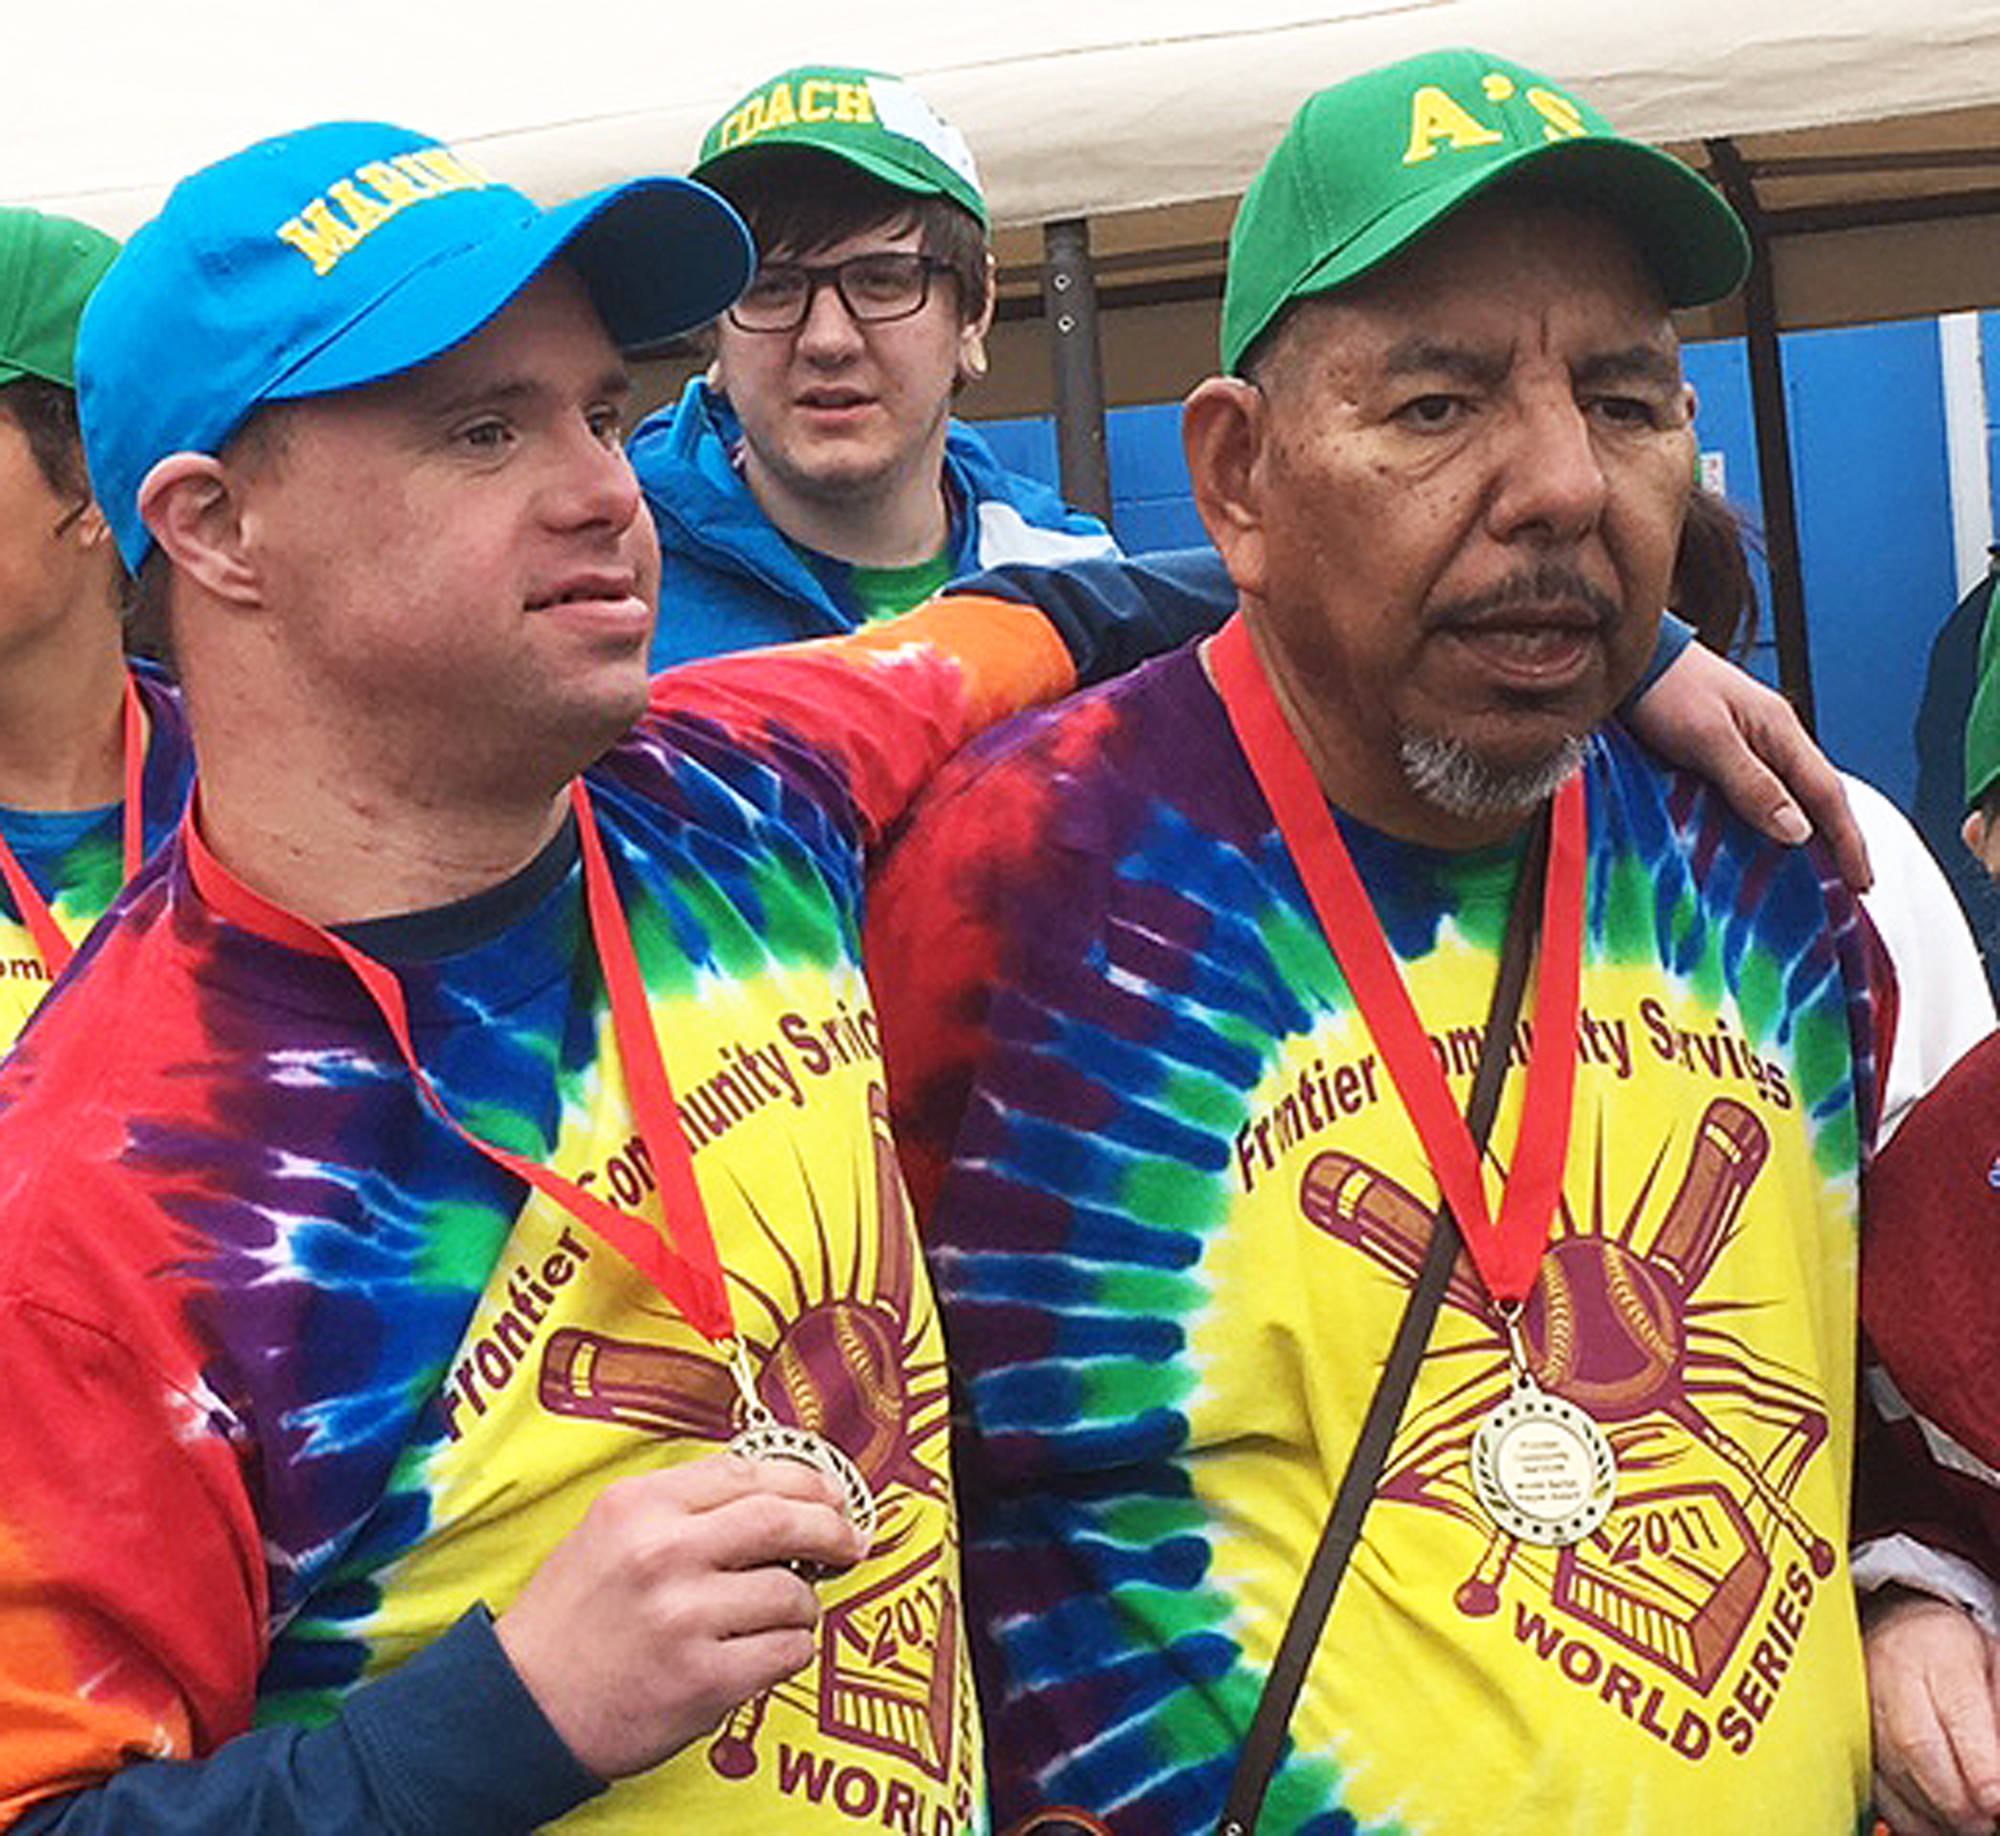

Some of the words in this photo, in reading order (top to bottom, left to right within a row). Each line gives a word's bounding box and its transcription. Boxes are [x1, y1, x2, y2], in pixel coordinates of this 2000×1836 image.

[720, 82, 876, 147] COACH
[1235, 1053, 1378, 1192] Frntier
[1611, 1506, 1720, 1565] 2017
[1514, 1601, 1711, 1761] WORLD
[1717, 1561, 1813, 1755] SERIES
